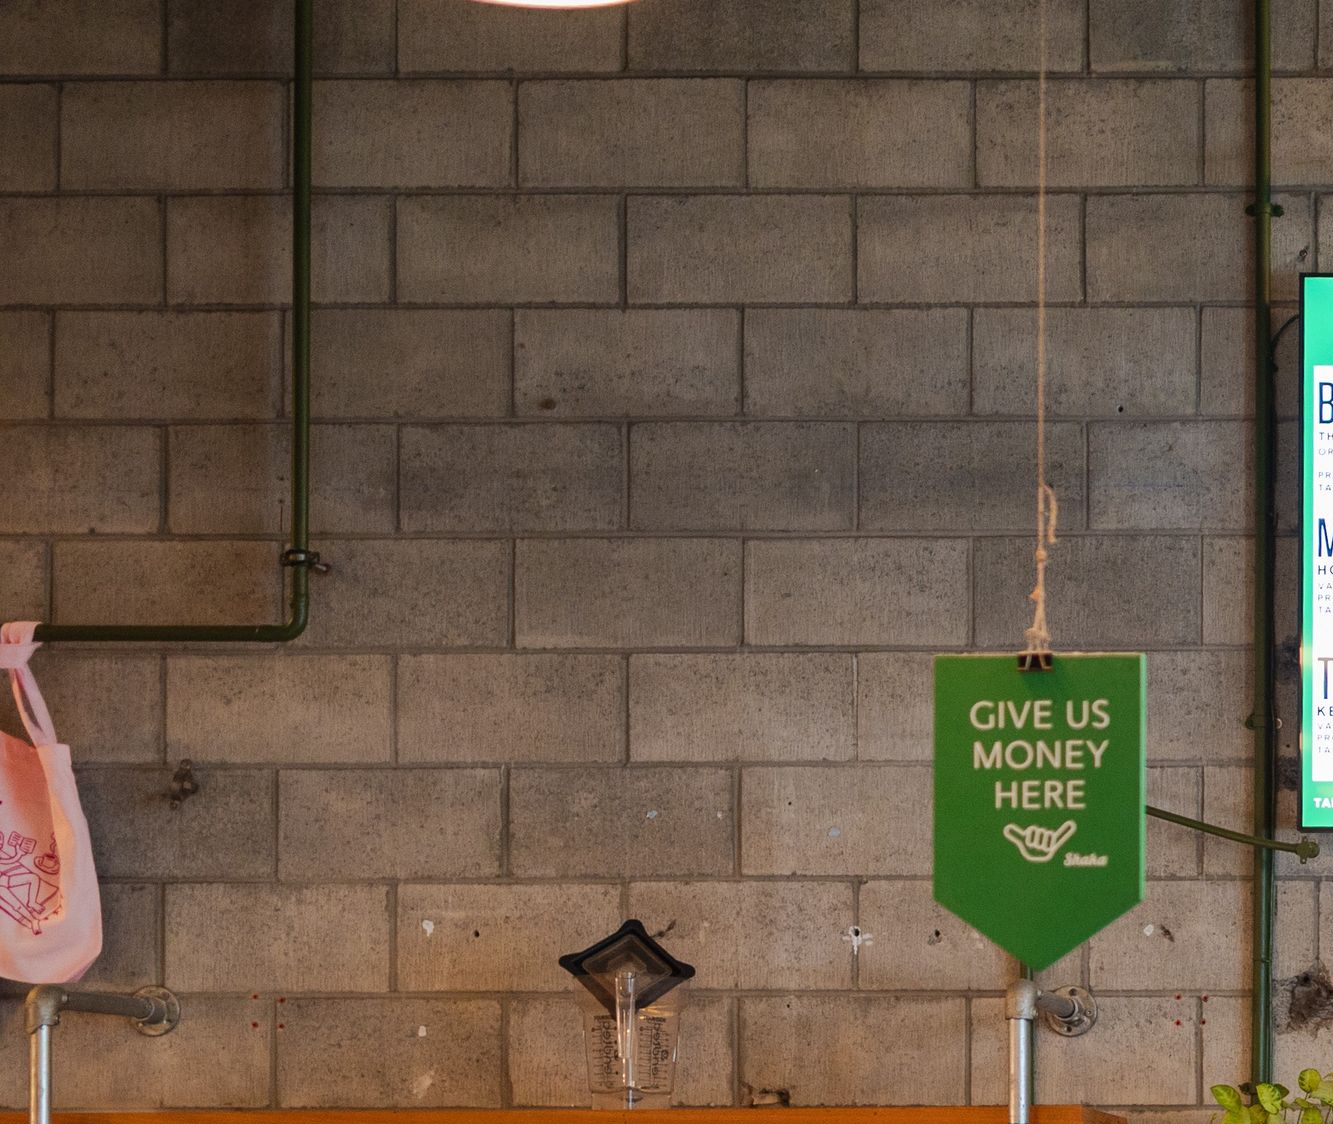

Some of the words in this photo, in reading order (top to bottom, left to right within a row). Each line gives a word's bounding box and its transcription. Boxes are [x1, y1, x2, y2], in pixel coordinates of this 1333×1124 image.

[969, 700, 1052, 731] GIVE
[1066, 699, 1110, 729] US
[973, 739, 1109, 770] MONEY
[995, 779, 1085, 809] HERE
